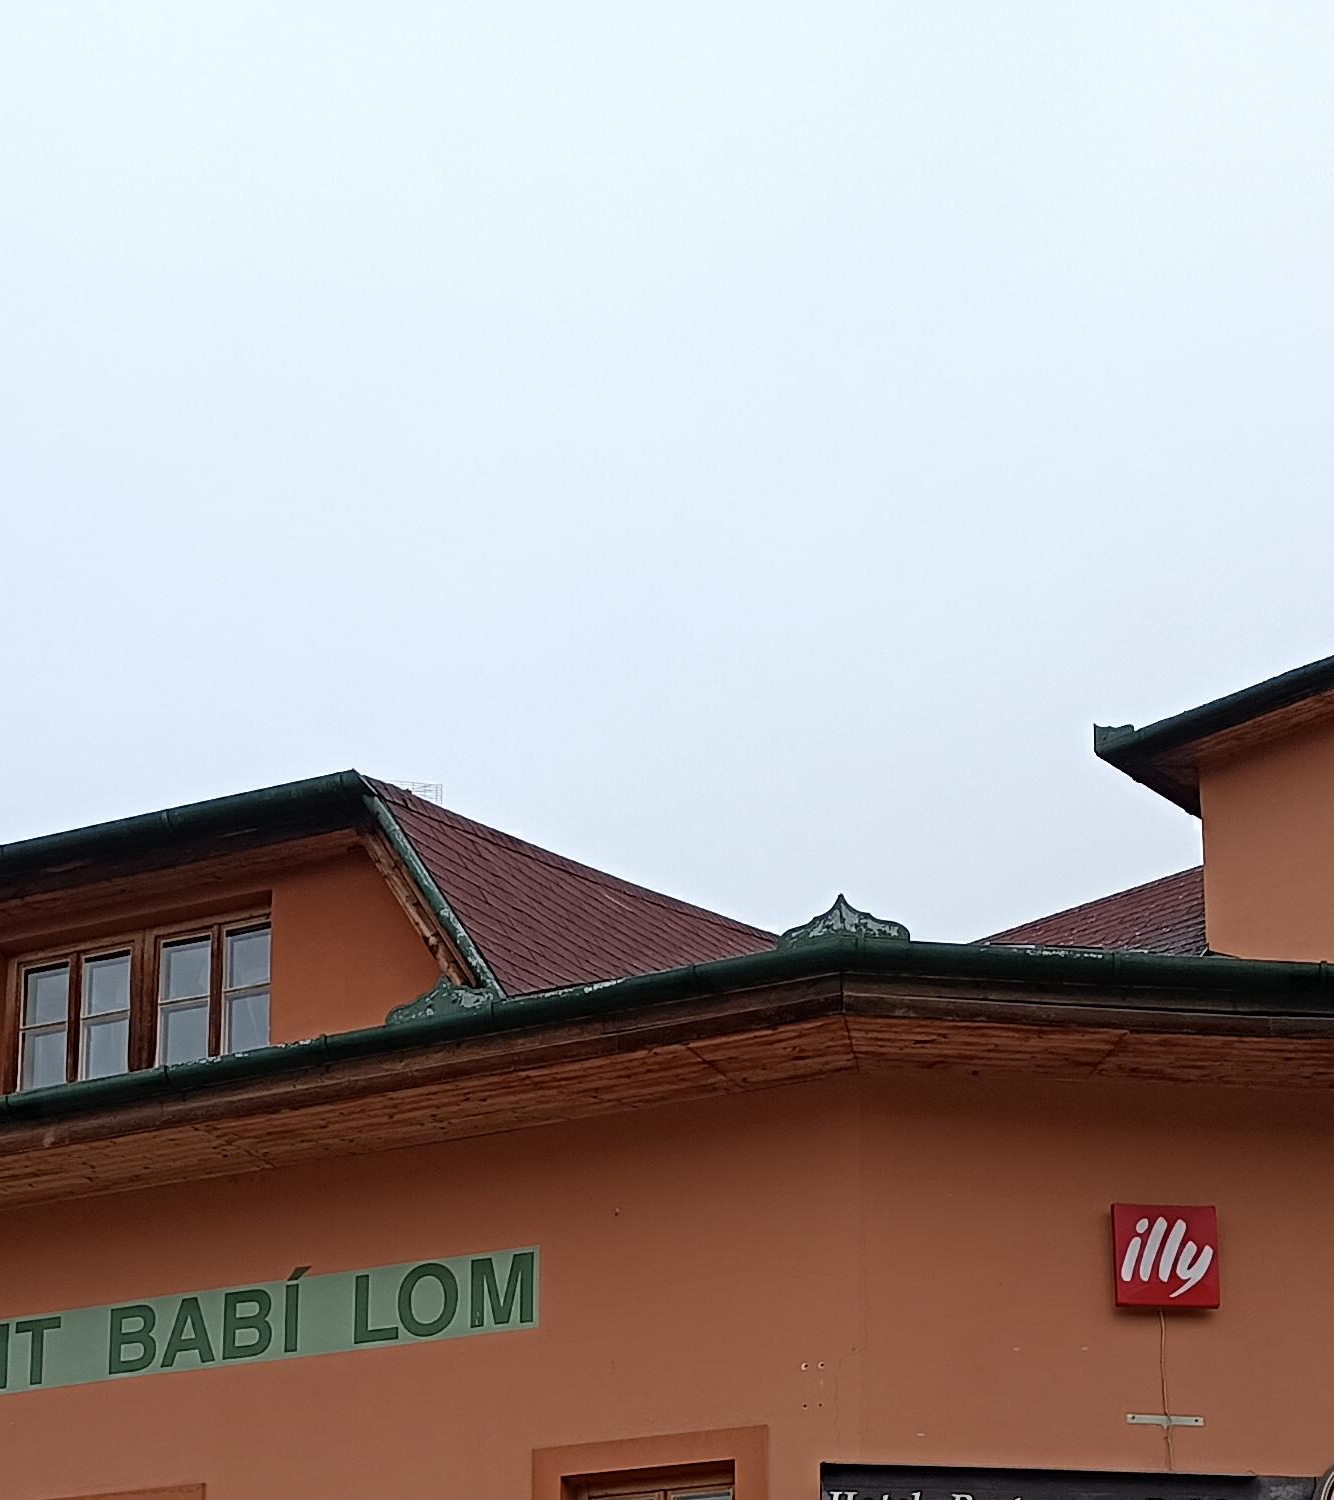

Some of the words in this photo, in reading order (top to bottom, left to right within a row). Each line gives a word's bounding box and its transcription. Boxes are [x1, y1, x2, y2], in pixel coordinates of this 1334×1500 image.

[1121, 1216, 1213, 1298] illy
[108, 1266, 312, 1377] BABÍ
[352, 1250, 537, 1345] LOM
